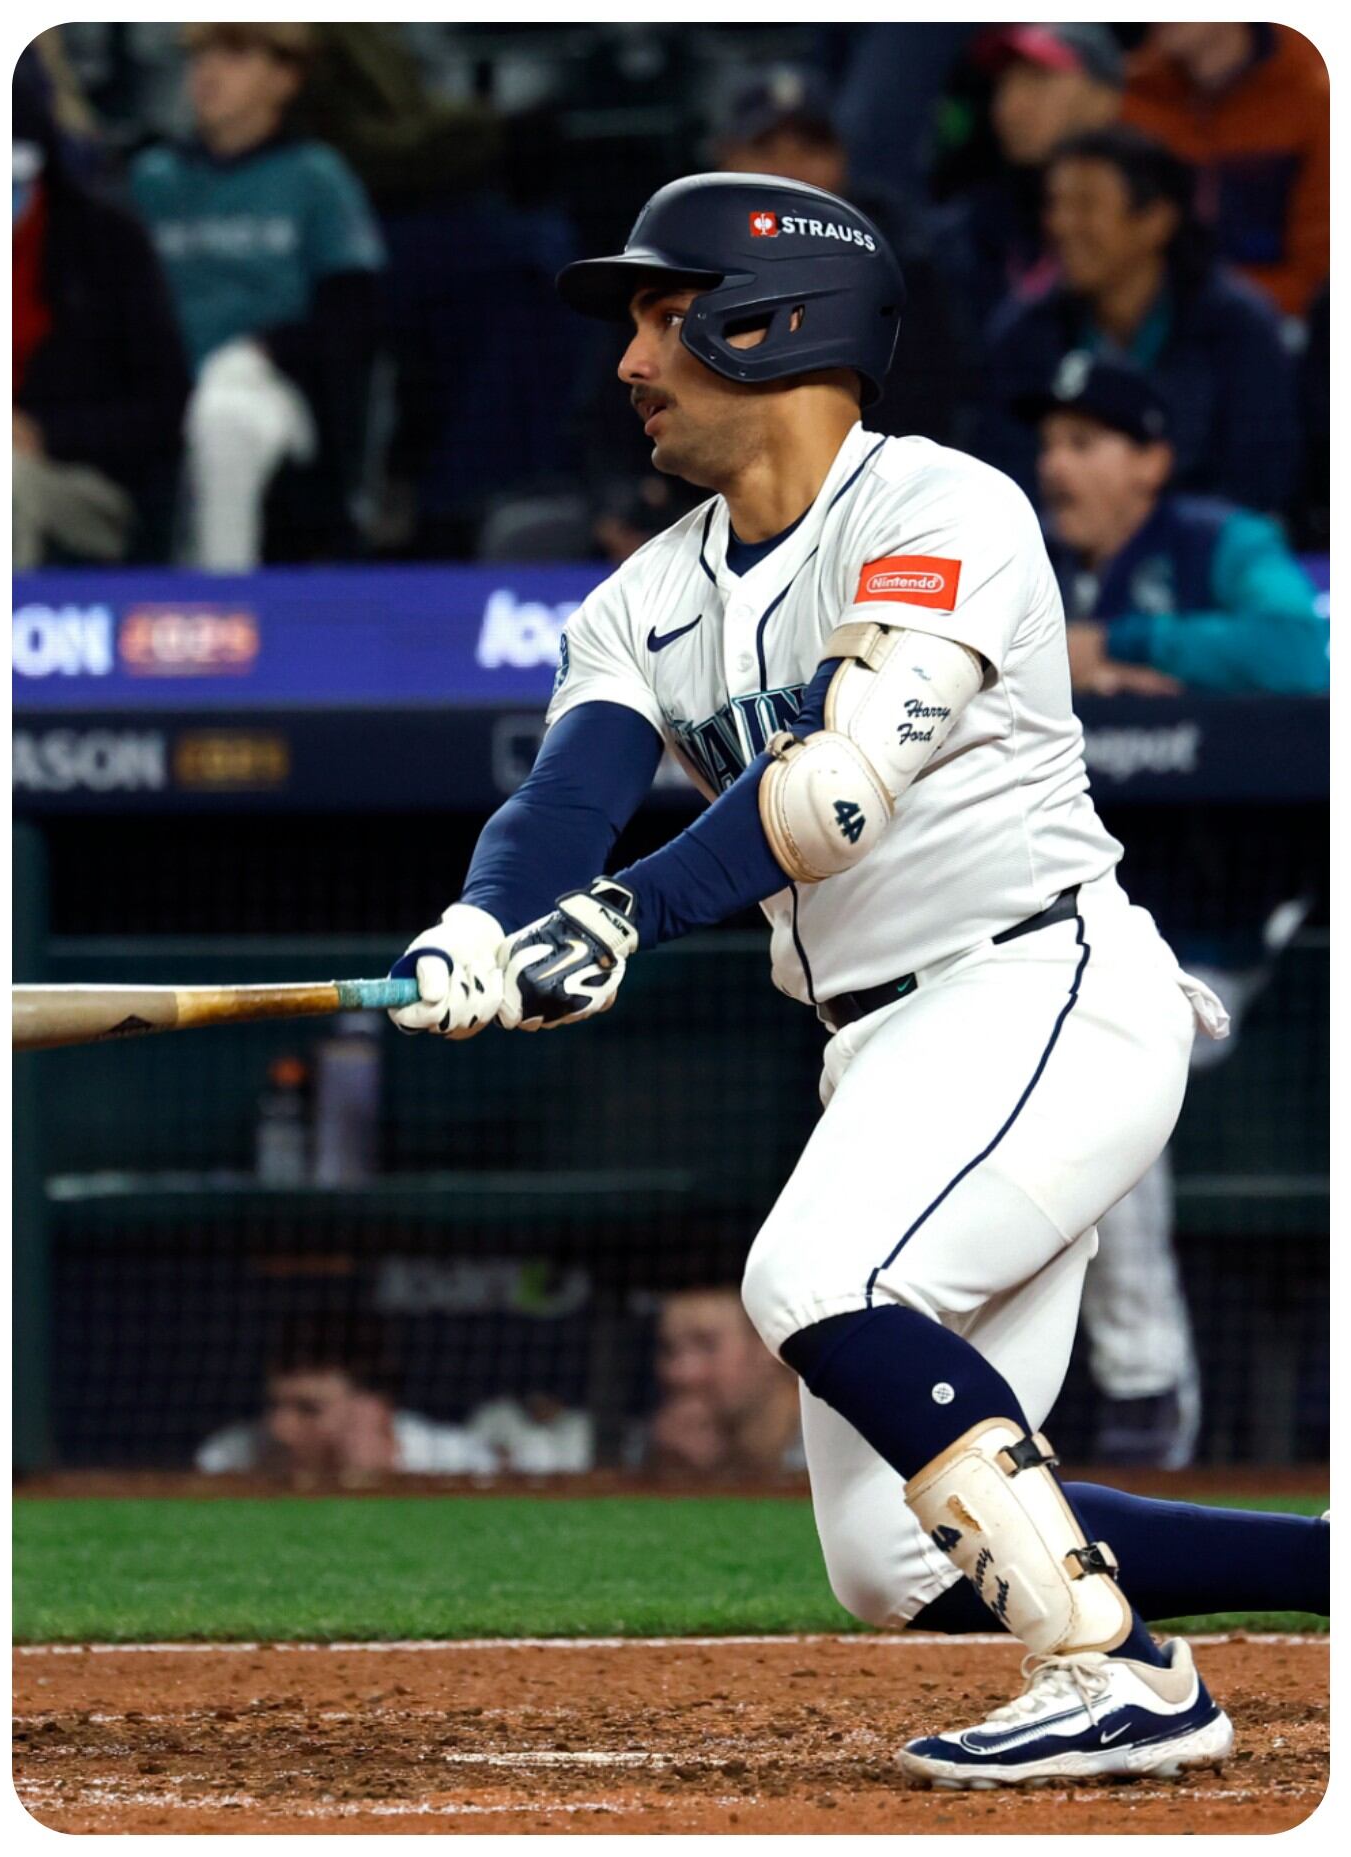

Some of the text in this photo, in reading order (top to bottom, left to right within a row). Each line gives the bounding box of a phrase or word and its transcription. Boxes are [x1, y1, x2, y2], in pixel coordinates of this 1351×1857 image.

[781, 216, 876, 252] STRAUSS
[871, 576, 937, 589] Nintendo
[903, 698, 952, 722] Harry
[896, 722, 935, 746] Ford
[832, 799, 866, 845] 44
